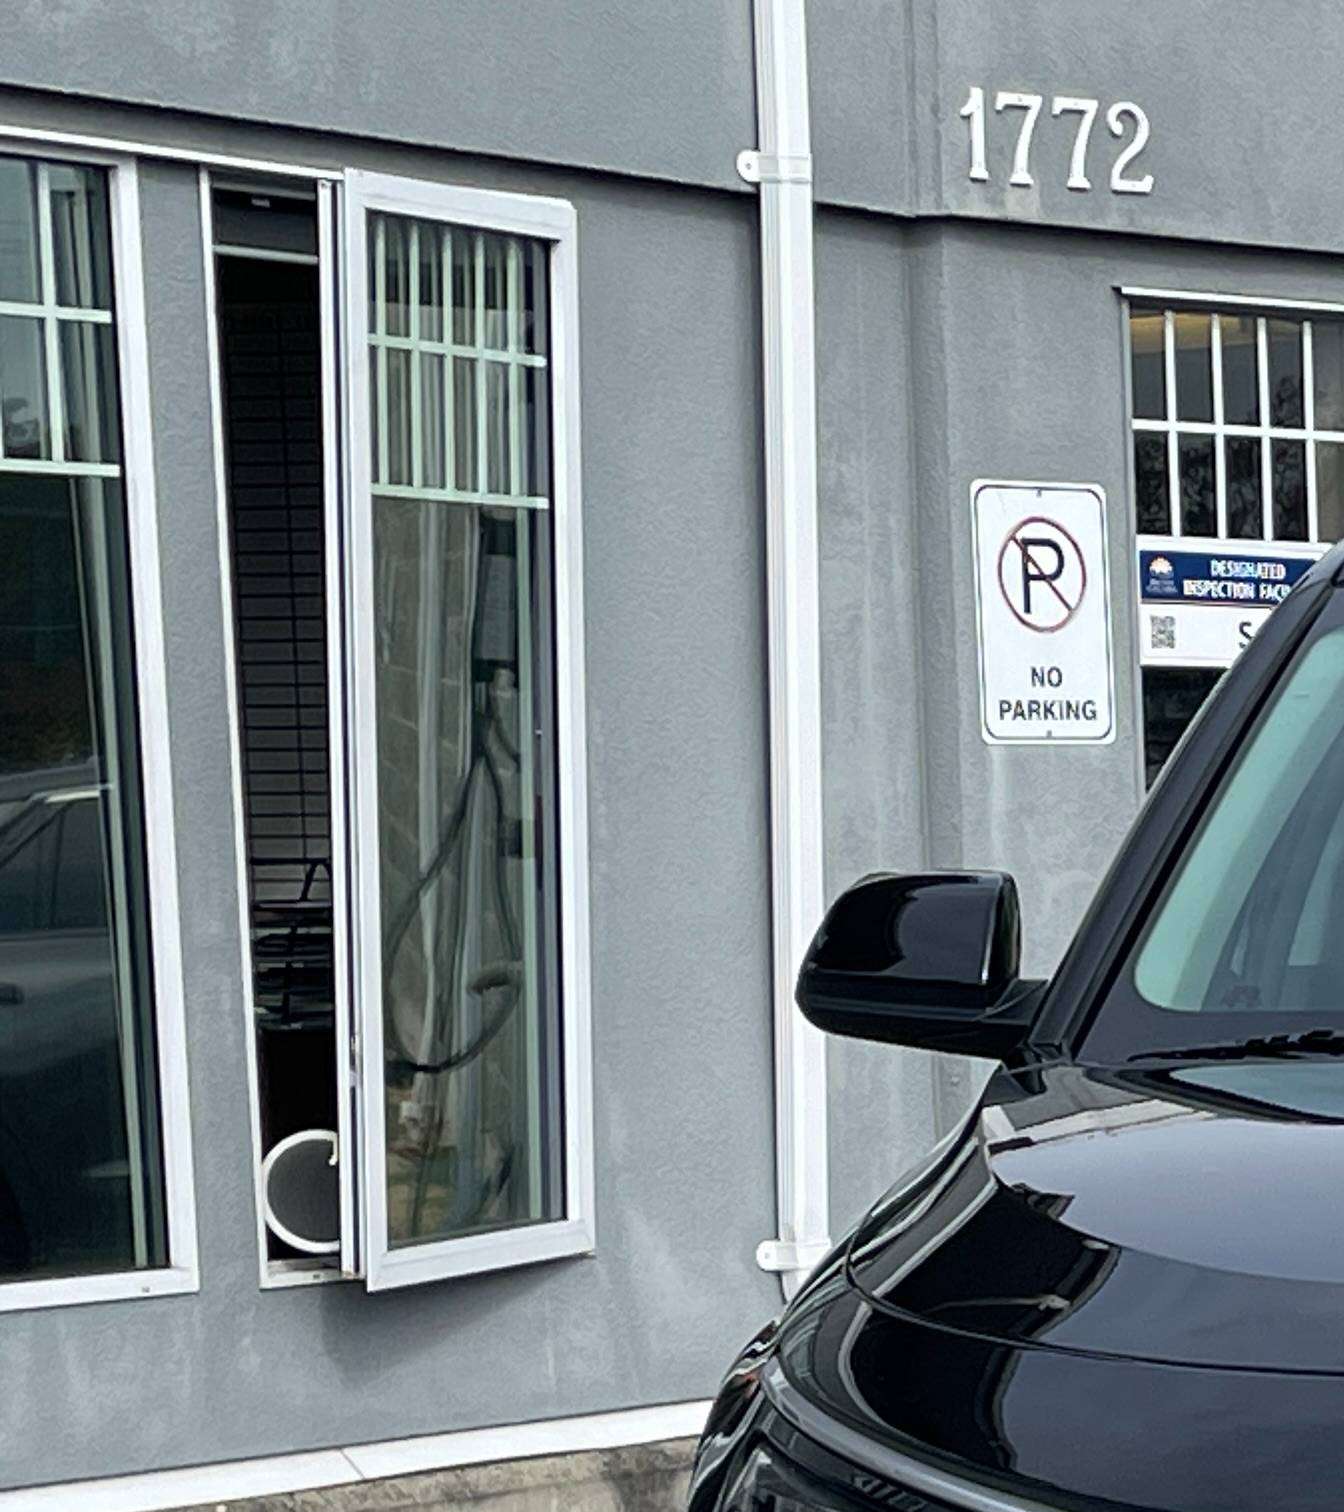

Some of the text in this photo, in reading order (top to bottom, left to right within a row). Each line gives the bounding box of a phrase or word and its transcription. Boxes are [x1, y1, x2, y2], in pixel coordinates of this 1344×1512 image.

[960, 87, 1154, 194] 1772
[1211, 559, 1287, 580] DESIGNATED
[1183, 579, 1255, 600] INSPECTION
[1030, 666, 1063, 688] NO
[998, 699, 1098, 721] PARKING
